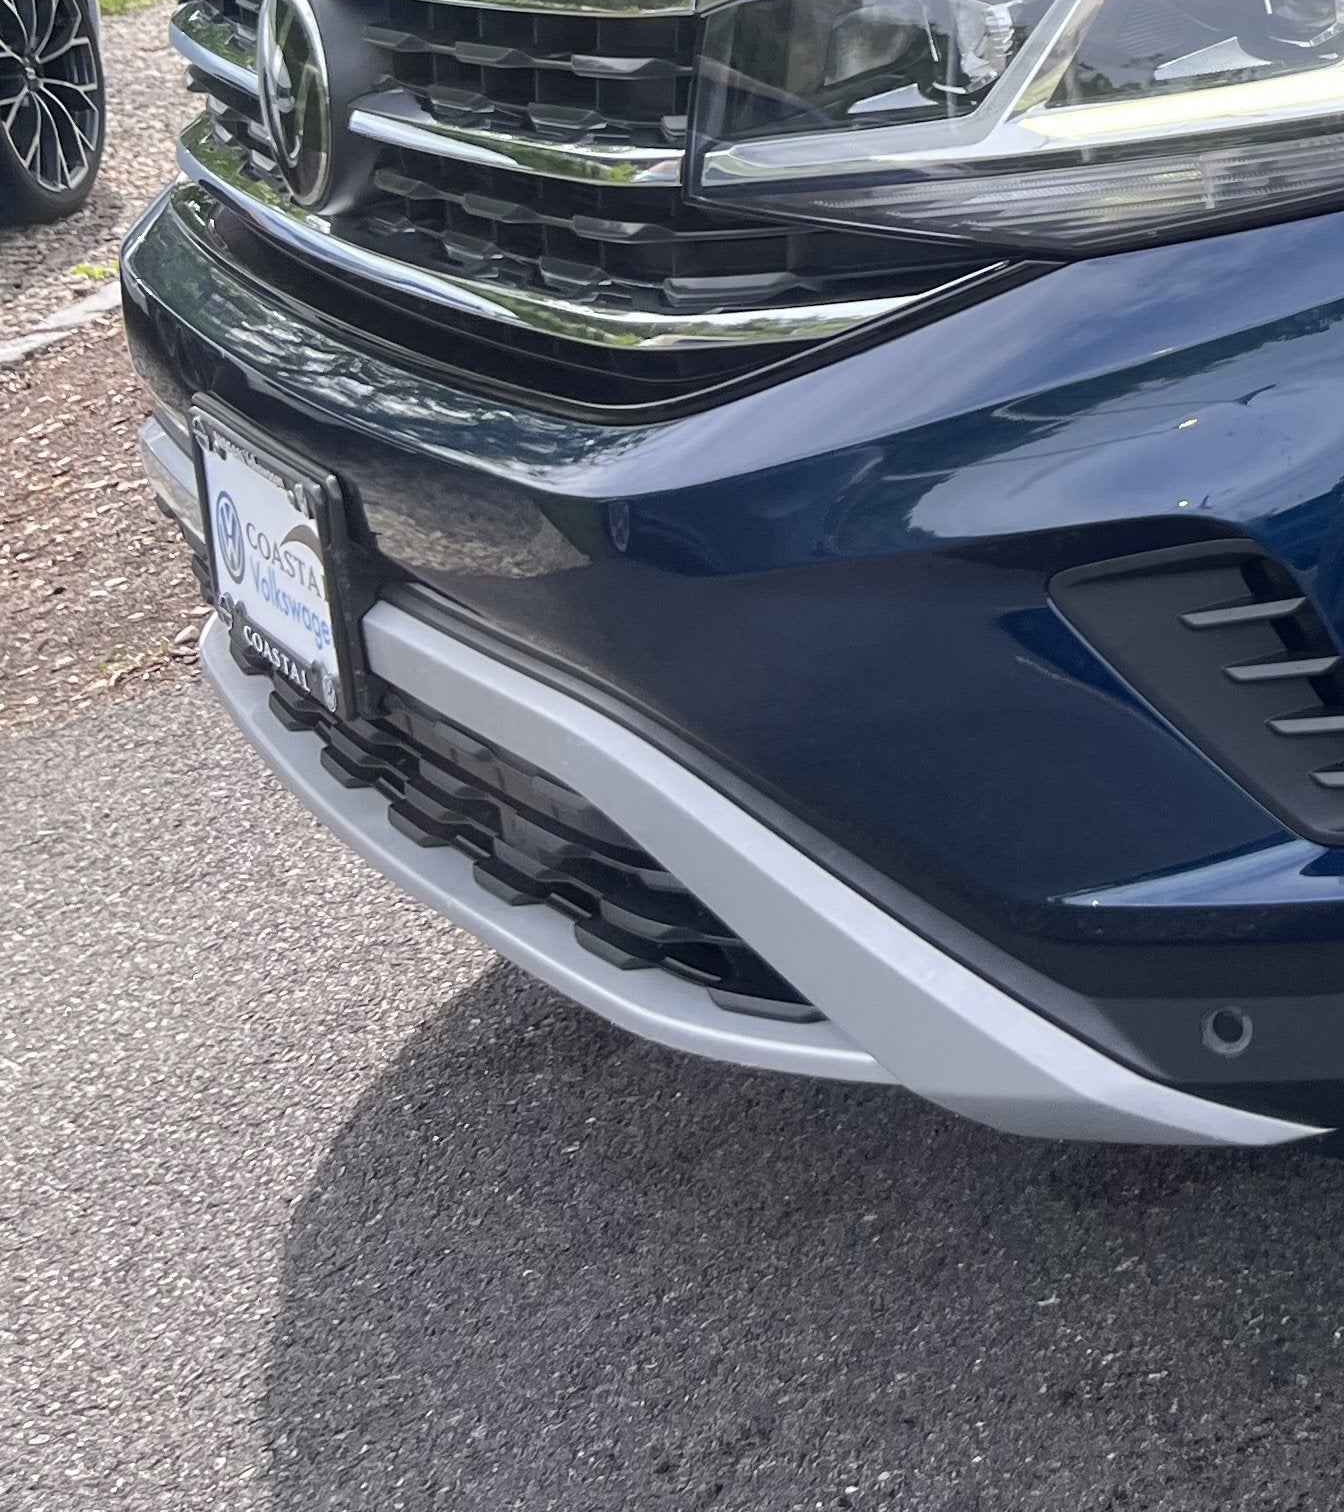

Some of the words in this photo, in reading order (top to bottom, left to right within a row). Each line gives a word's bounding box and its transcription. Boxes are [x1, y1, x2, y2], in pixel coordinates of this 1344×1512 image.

[246, 522, 323, 599] COASTA
[251, 560, 331, 650] Volkswage
[243, 625, 311, 693] COASTAL
